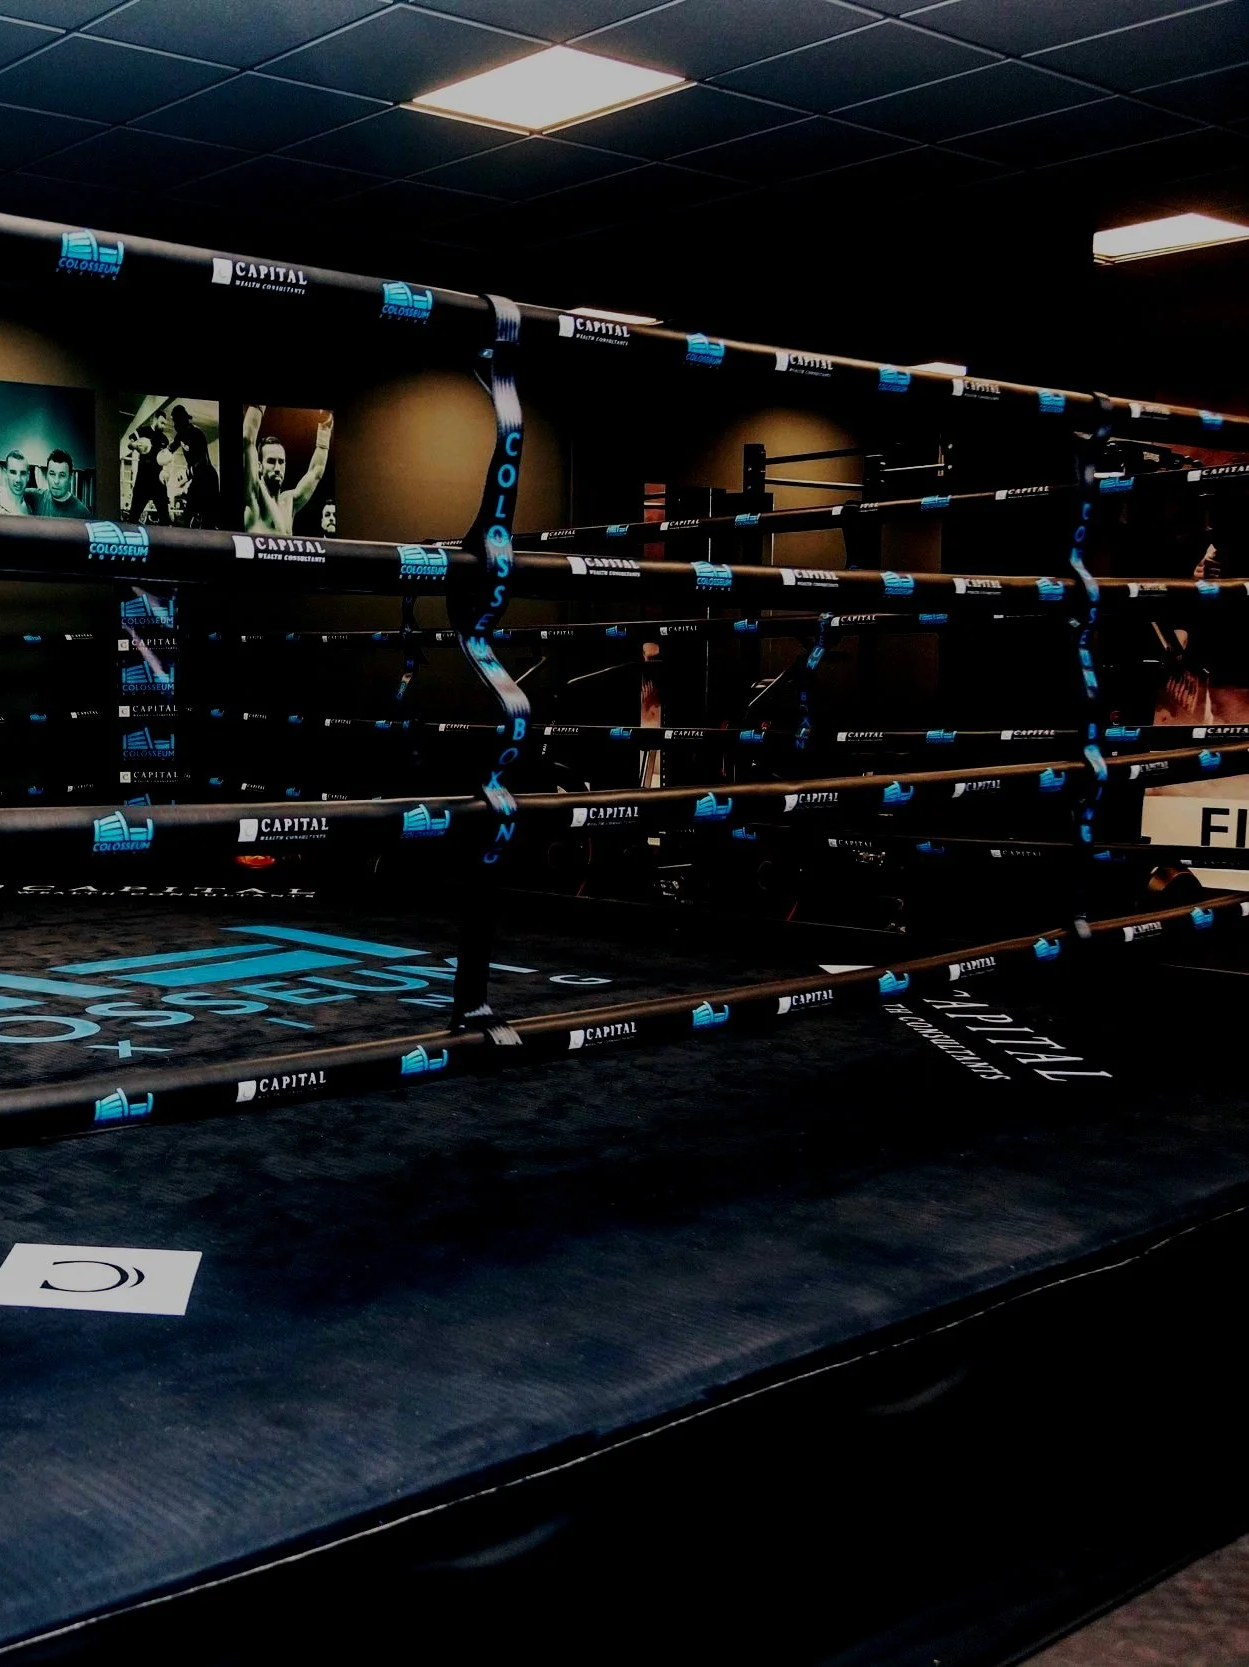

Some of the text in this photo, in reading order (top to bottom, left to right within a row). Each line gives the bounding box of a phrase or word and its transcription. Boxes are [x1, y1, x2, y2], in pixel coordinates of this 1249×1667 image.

[58, 258, 121, 277] COLOSSEUM
[235, 262, 307, 286] CAPITAL
[235, 279, 306, 296] WEALTH CONSULTANTS
[381, 304, 430, 321] COLOSSEUM
[575, 318, 631, 338] CAPITAL
[1007, 486, 1050, 497] CAPITAL
[669, 519, 700, 528] CAPITAL
[90, 543, 148, 557] COLOSSEUM
[255, 537, 326, 555] CAPITAL
[258, 552, 326, 564] WEALTH CONSULTANTS
[400, 565, 447, 577] COLOSSEUM
[841, 614, 877, 623] CAPITAL
[122, 682, 175, 692] COLOSSEUM
[133, 704, 179, 713] CAPITAL
[134, 771, 180, 780] CAPITAL
[798, 792, 839, 804] CAPITAL
[590, 806, 639, 819] CAPITAL
[261, 817, 329, 833] CAPITAL
[93, 842, 150, 852] COLOSSEUM
[960, 956, 997, 972] CAPITAL
[792, 989, 834, 1006] CAPITAL
[586, 1021, 638, 1040] CAPITAL
[897, 1016, 1012, 1080] CONSULTANTS
[259, 1070, 327, 1092] CAPITAL
